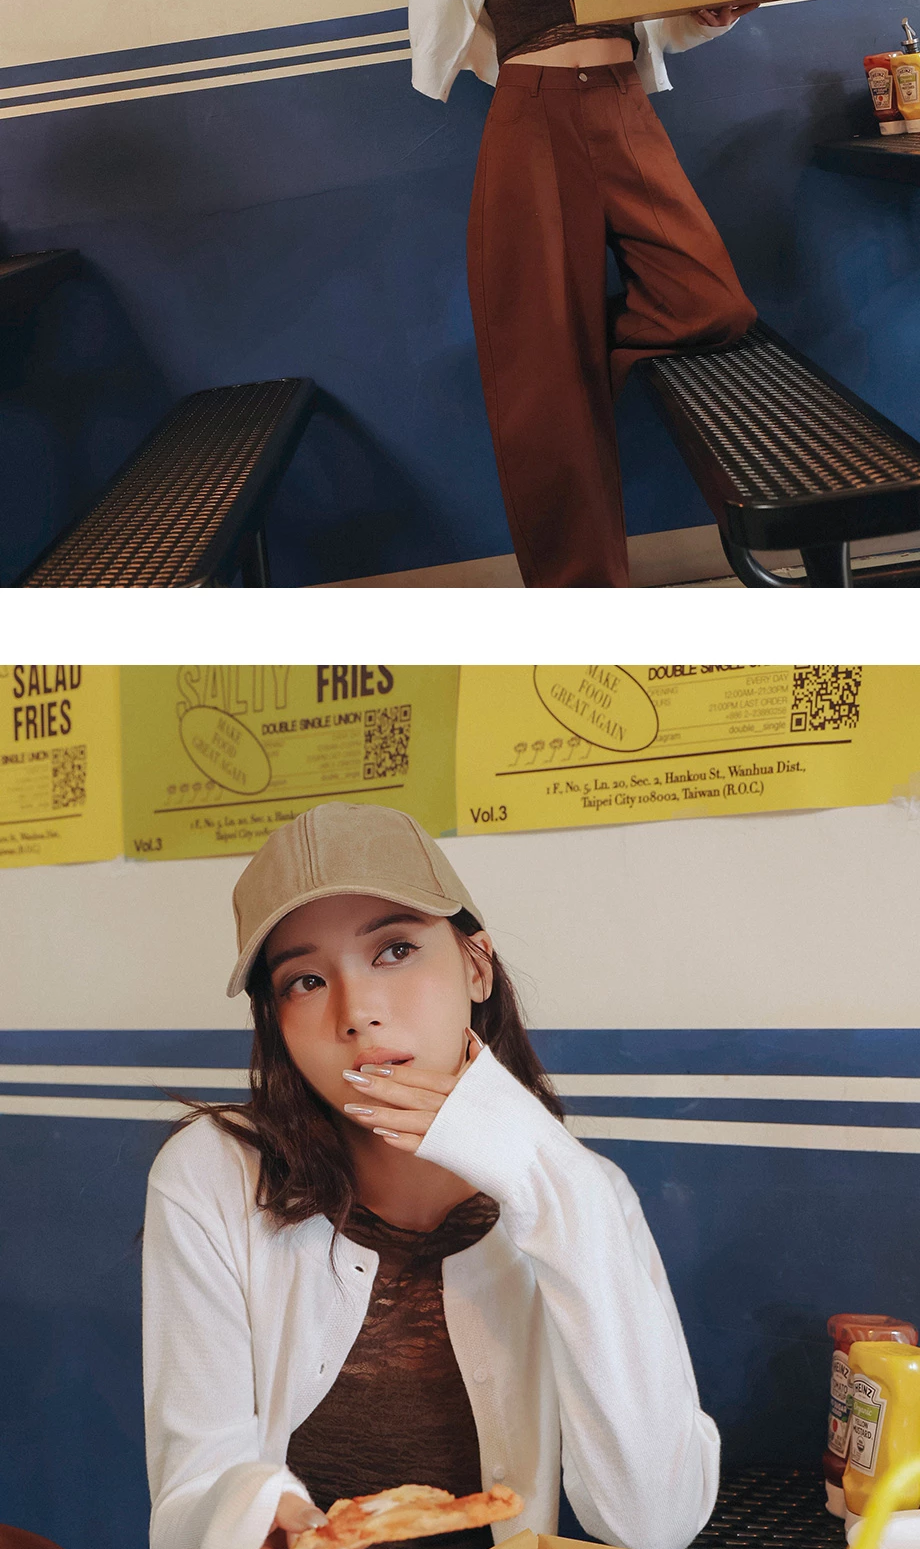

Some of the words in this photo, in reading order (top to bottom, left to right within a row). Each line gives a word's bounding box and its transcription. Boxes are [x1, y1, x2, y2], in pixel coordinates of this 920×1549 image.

[578, 679, 612, 709] FOOD
[13, 699, 71, 741] FRIES
[550, 683, 589, 717] GREAT
[590, 710, 627, 742] AGAIN
[581, 795, 612, 811] Taipei
[615, 794, 635, 808] City
[638, 792, 679, 803] 108002,
[682, 788, 720, 799] Taiwan
[722, 781, 764, 798] (R.O.C.)
[470, 806, 508, 823] Vol.3
[855, 1382, 872, 1398] HEINZ
